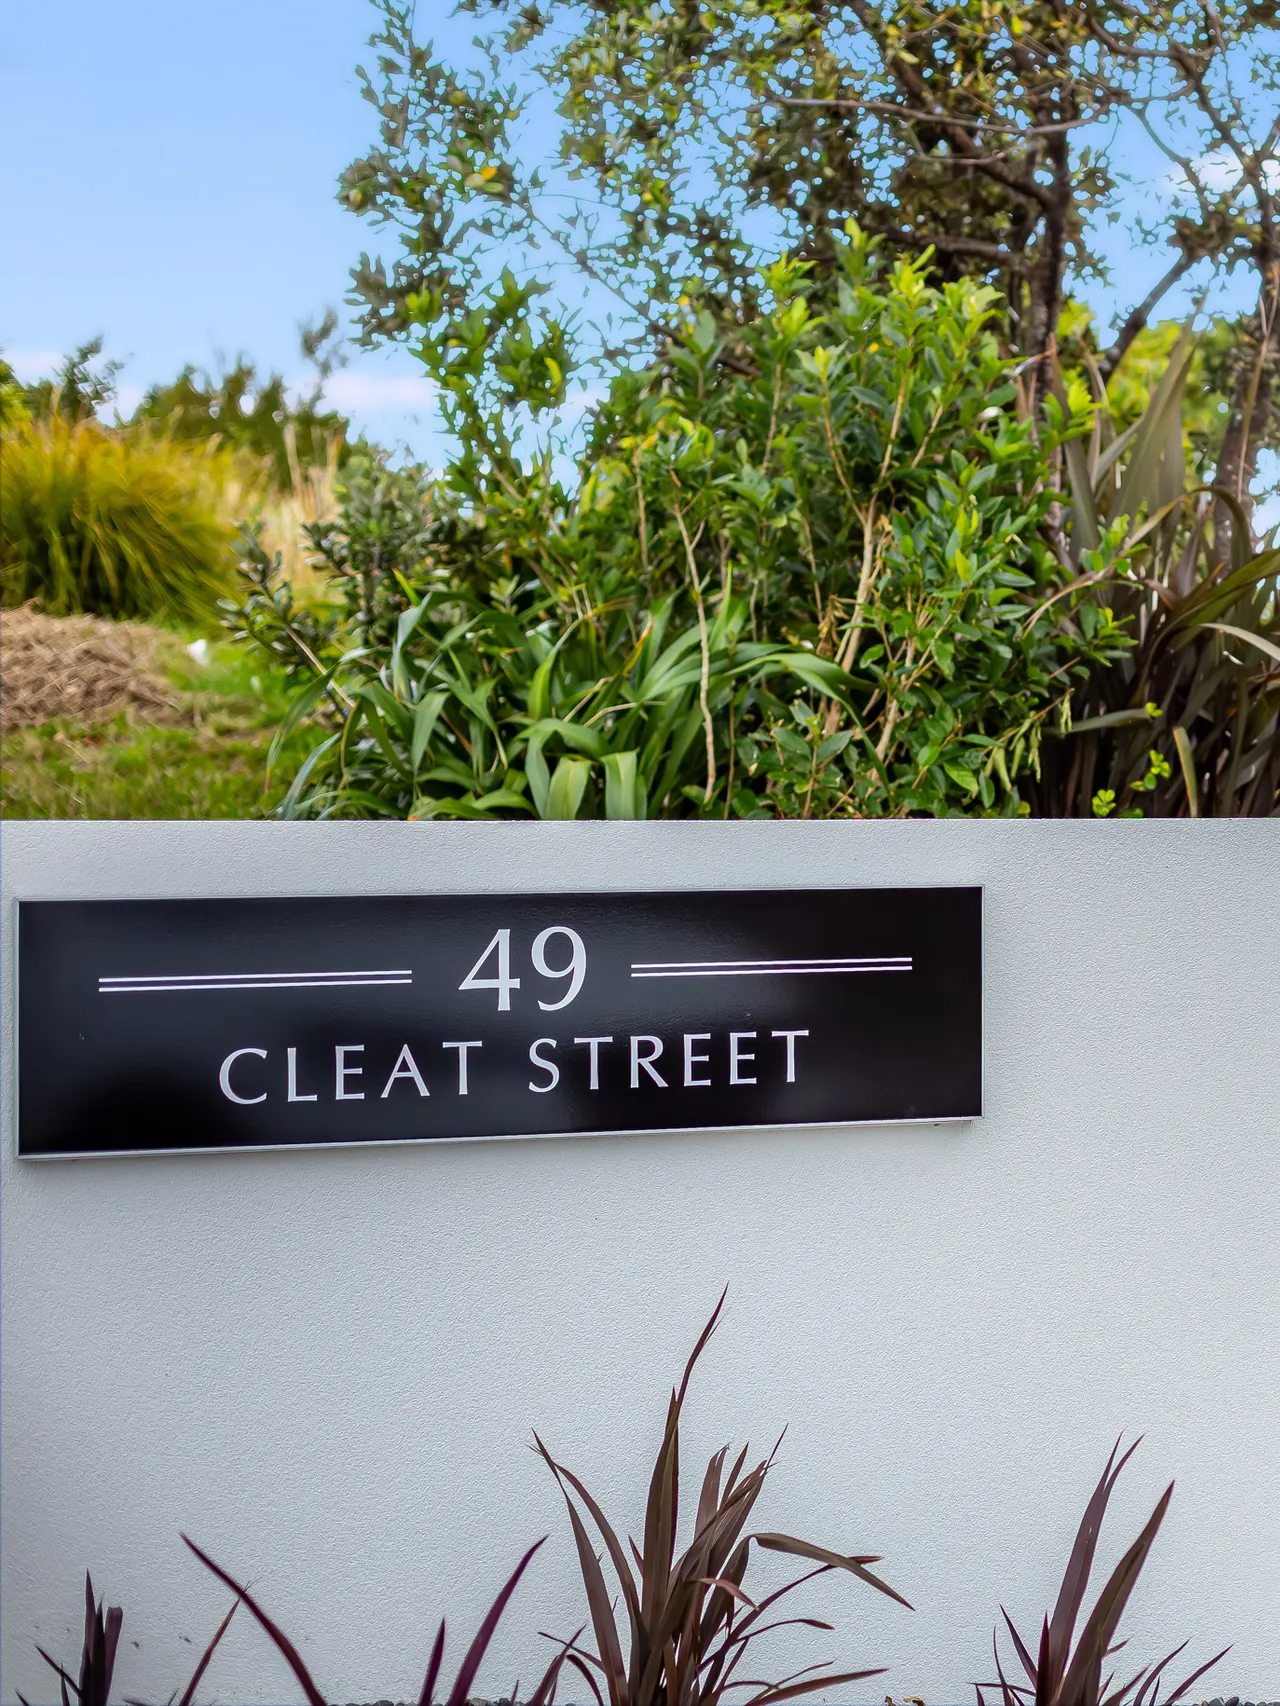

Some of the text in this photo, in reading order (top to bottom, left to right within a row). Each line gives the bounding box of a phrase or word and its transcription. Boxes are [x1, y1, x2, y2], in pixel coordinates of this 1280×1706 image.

[457, 926, 588, 1012] 49
[218, 1029, 811, 1105] CLEAT STREET
